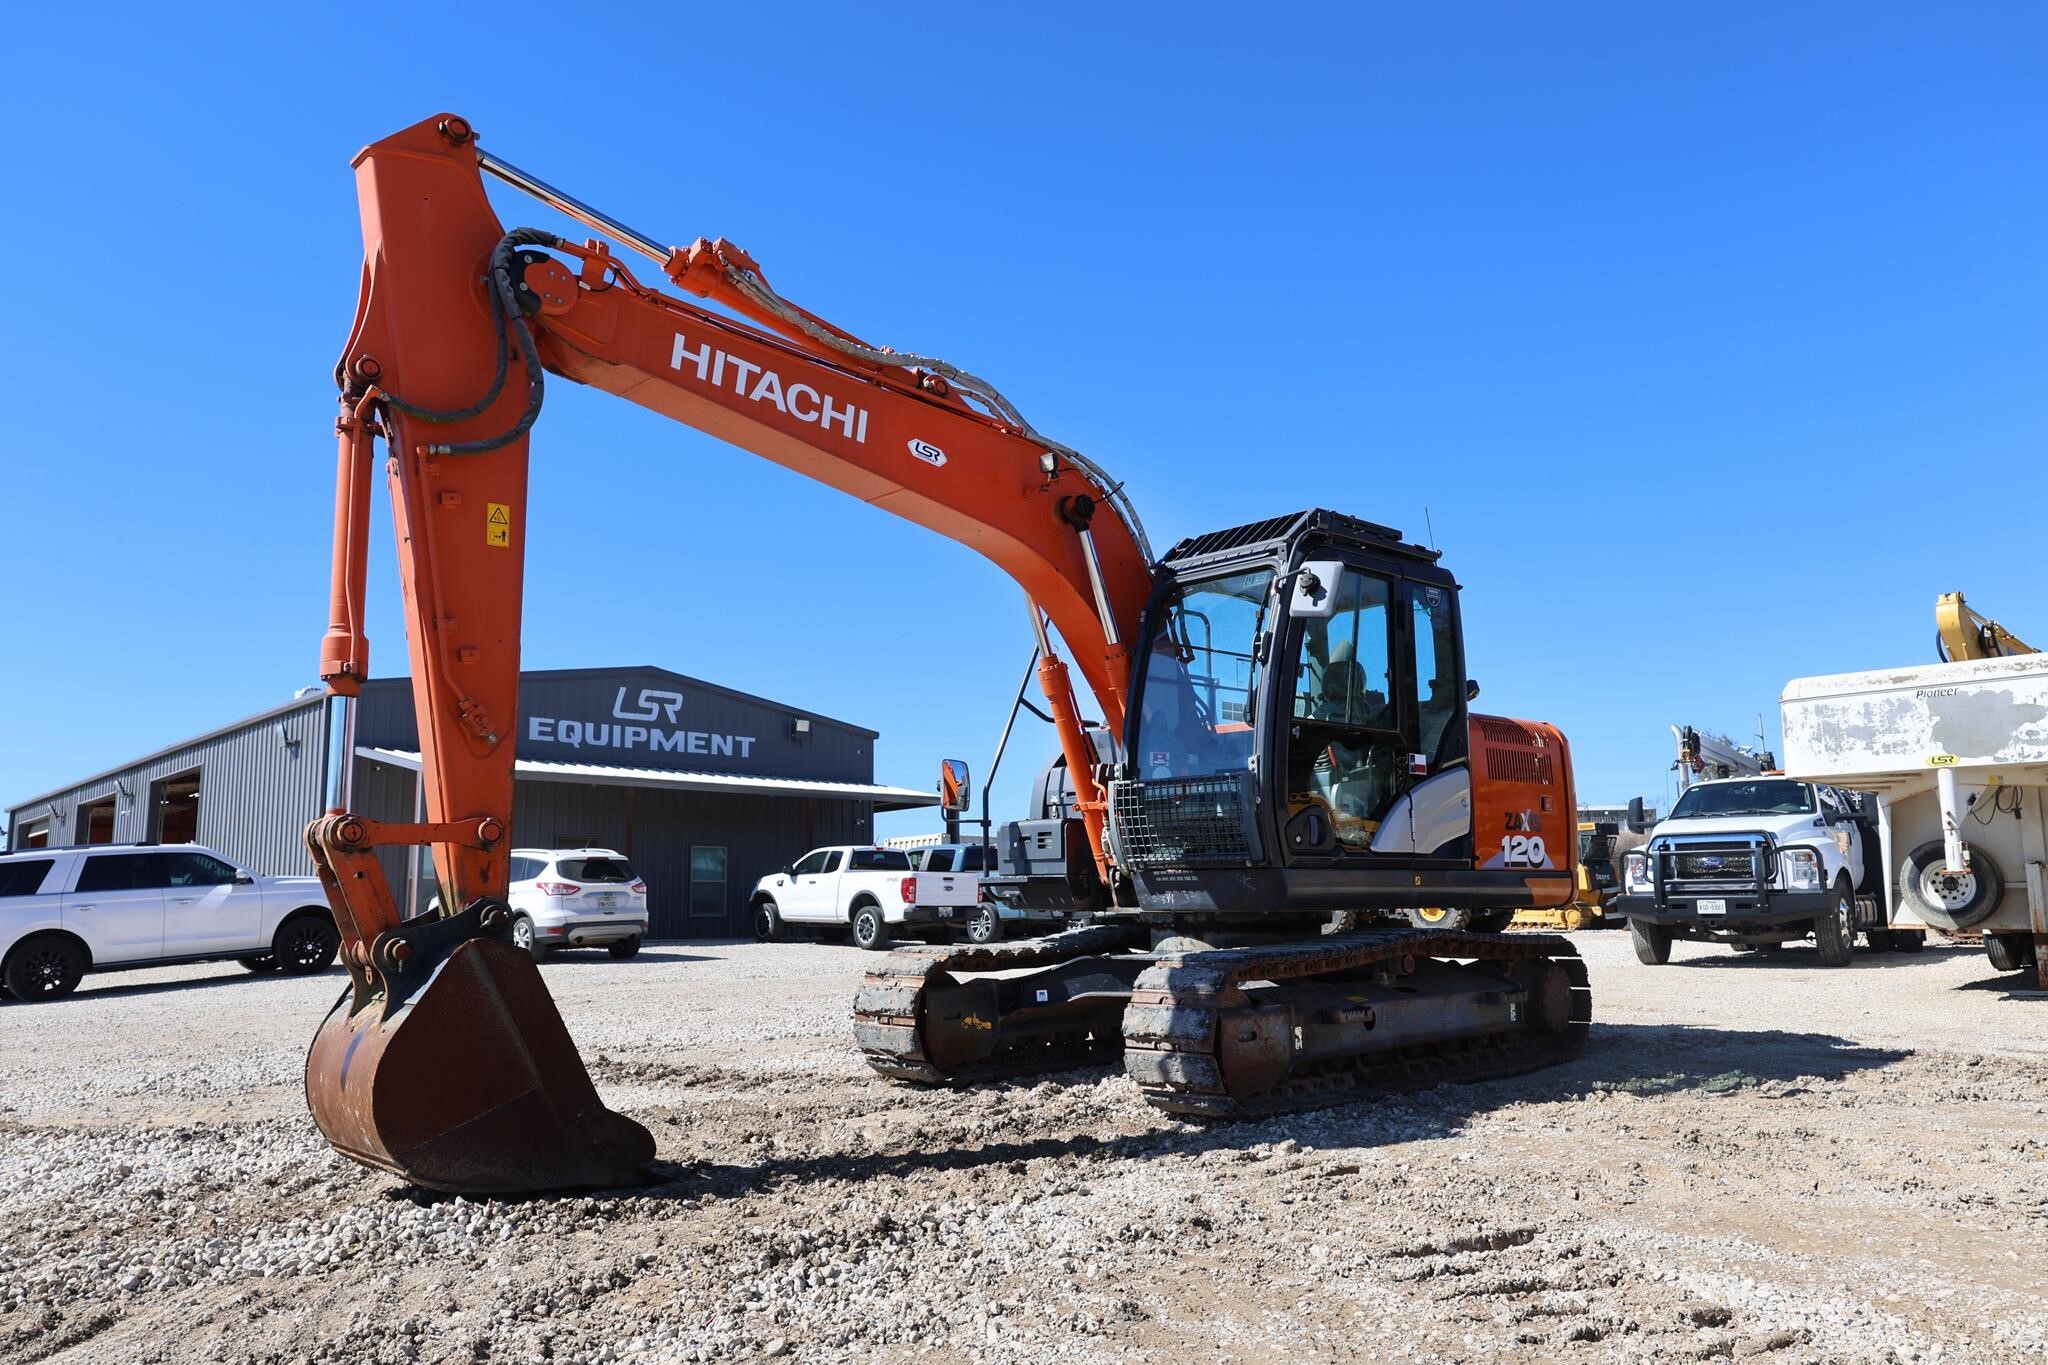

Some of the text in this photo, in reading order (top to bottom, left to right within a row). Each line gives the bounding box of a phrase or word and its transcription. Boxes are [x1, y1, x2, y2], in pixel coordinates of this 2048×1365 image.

[670, 332, 869, 444] HITACHI
[915, 441, 941, 461] LSR
[612, 686, 684, 725] LSR
[1916, 687, 1959, 699] Pioneer
[528, 716, 756, 759] EQUIPMENT
[1931, 755, 1954, 764] LSR
[1501, 834, 1545, 868] 120
